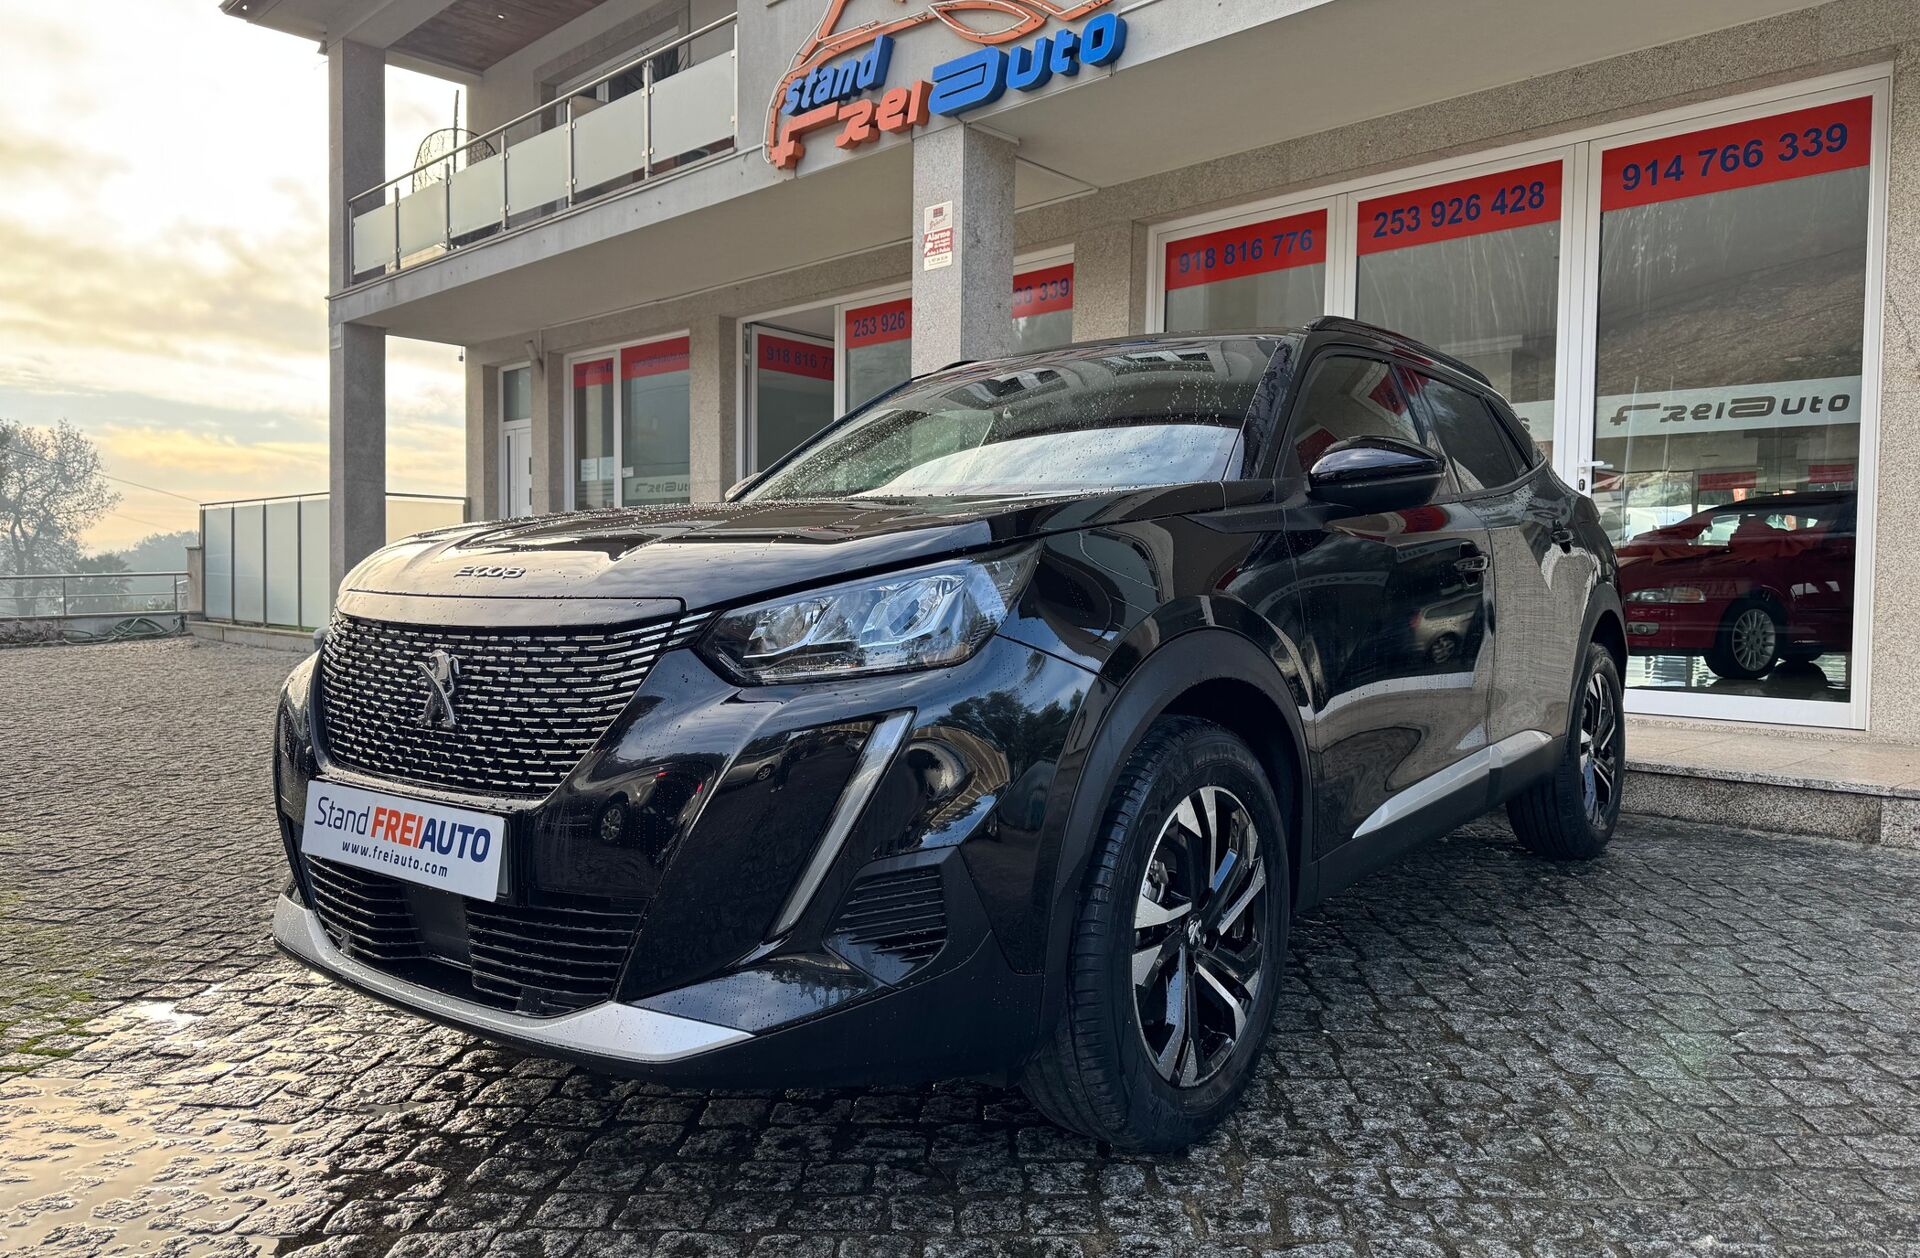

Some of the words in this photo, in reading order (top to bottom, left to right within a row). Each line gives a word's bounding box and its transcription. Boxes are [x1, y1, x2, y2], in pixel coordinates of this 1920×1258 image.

[782, 34, 892, 116] stand
[1622, 154, 1684, 191] 914
[1698, 139, 1764, 177] 766
[1778, 122, 1848, 162] 339
[1373, 206, 1421, 238] 253
[1431, 194, 1481, 228] 926
[1490, 181, 1545, 216] 428
[1179, 247, 1216, 273] 918
[1224, 238, 1264, 265] 816
[1272, 228, 1313, 257] 776
[1039, 278, 1070, 301] 339
[853, 316, 877, 338] 253
[881, 311, 906, 332] 926
[767, 346, 790, 365] 918
[794, 351, 817, 369] 816
[454, 566, 527, 579] 2008
[314, 796, 371, 836] Stand
[370, 806, 491, 863] FREIAUTO
[342, 840, 448, 878] www.freiauto.com
